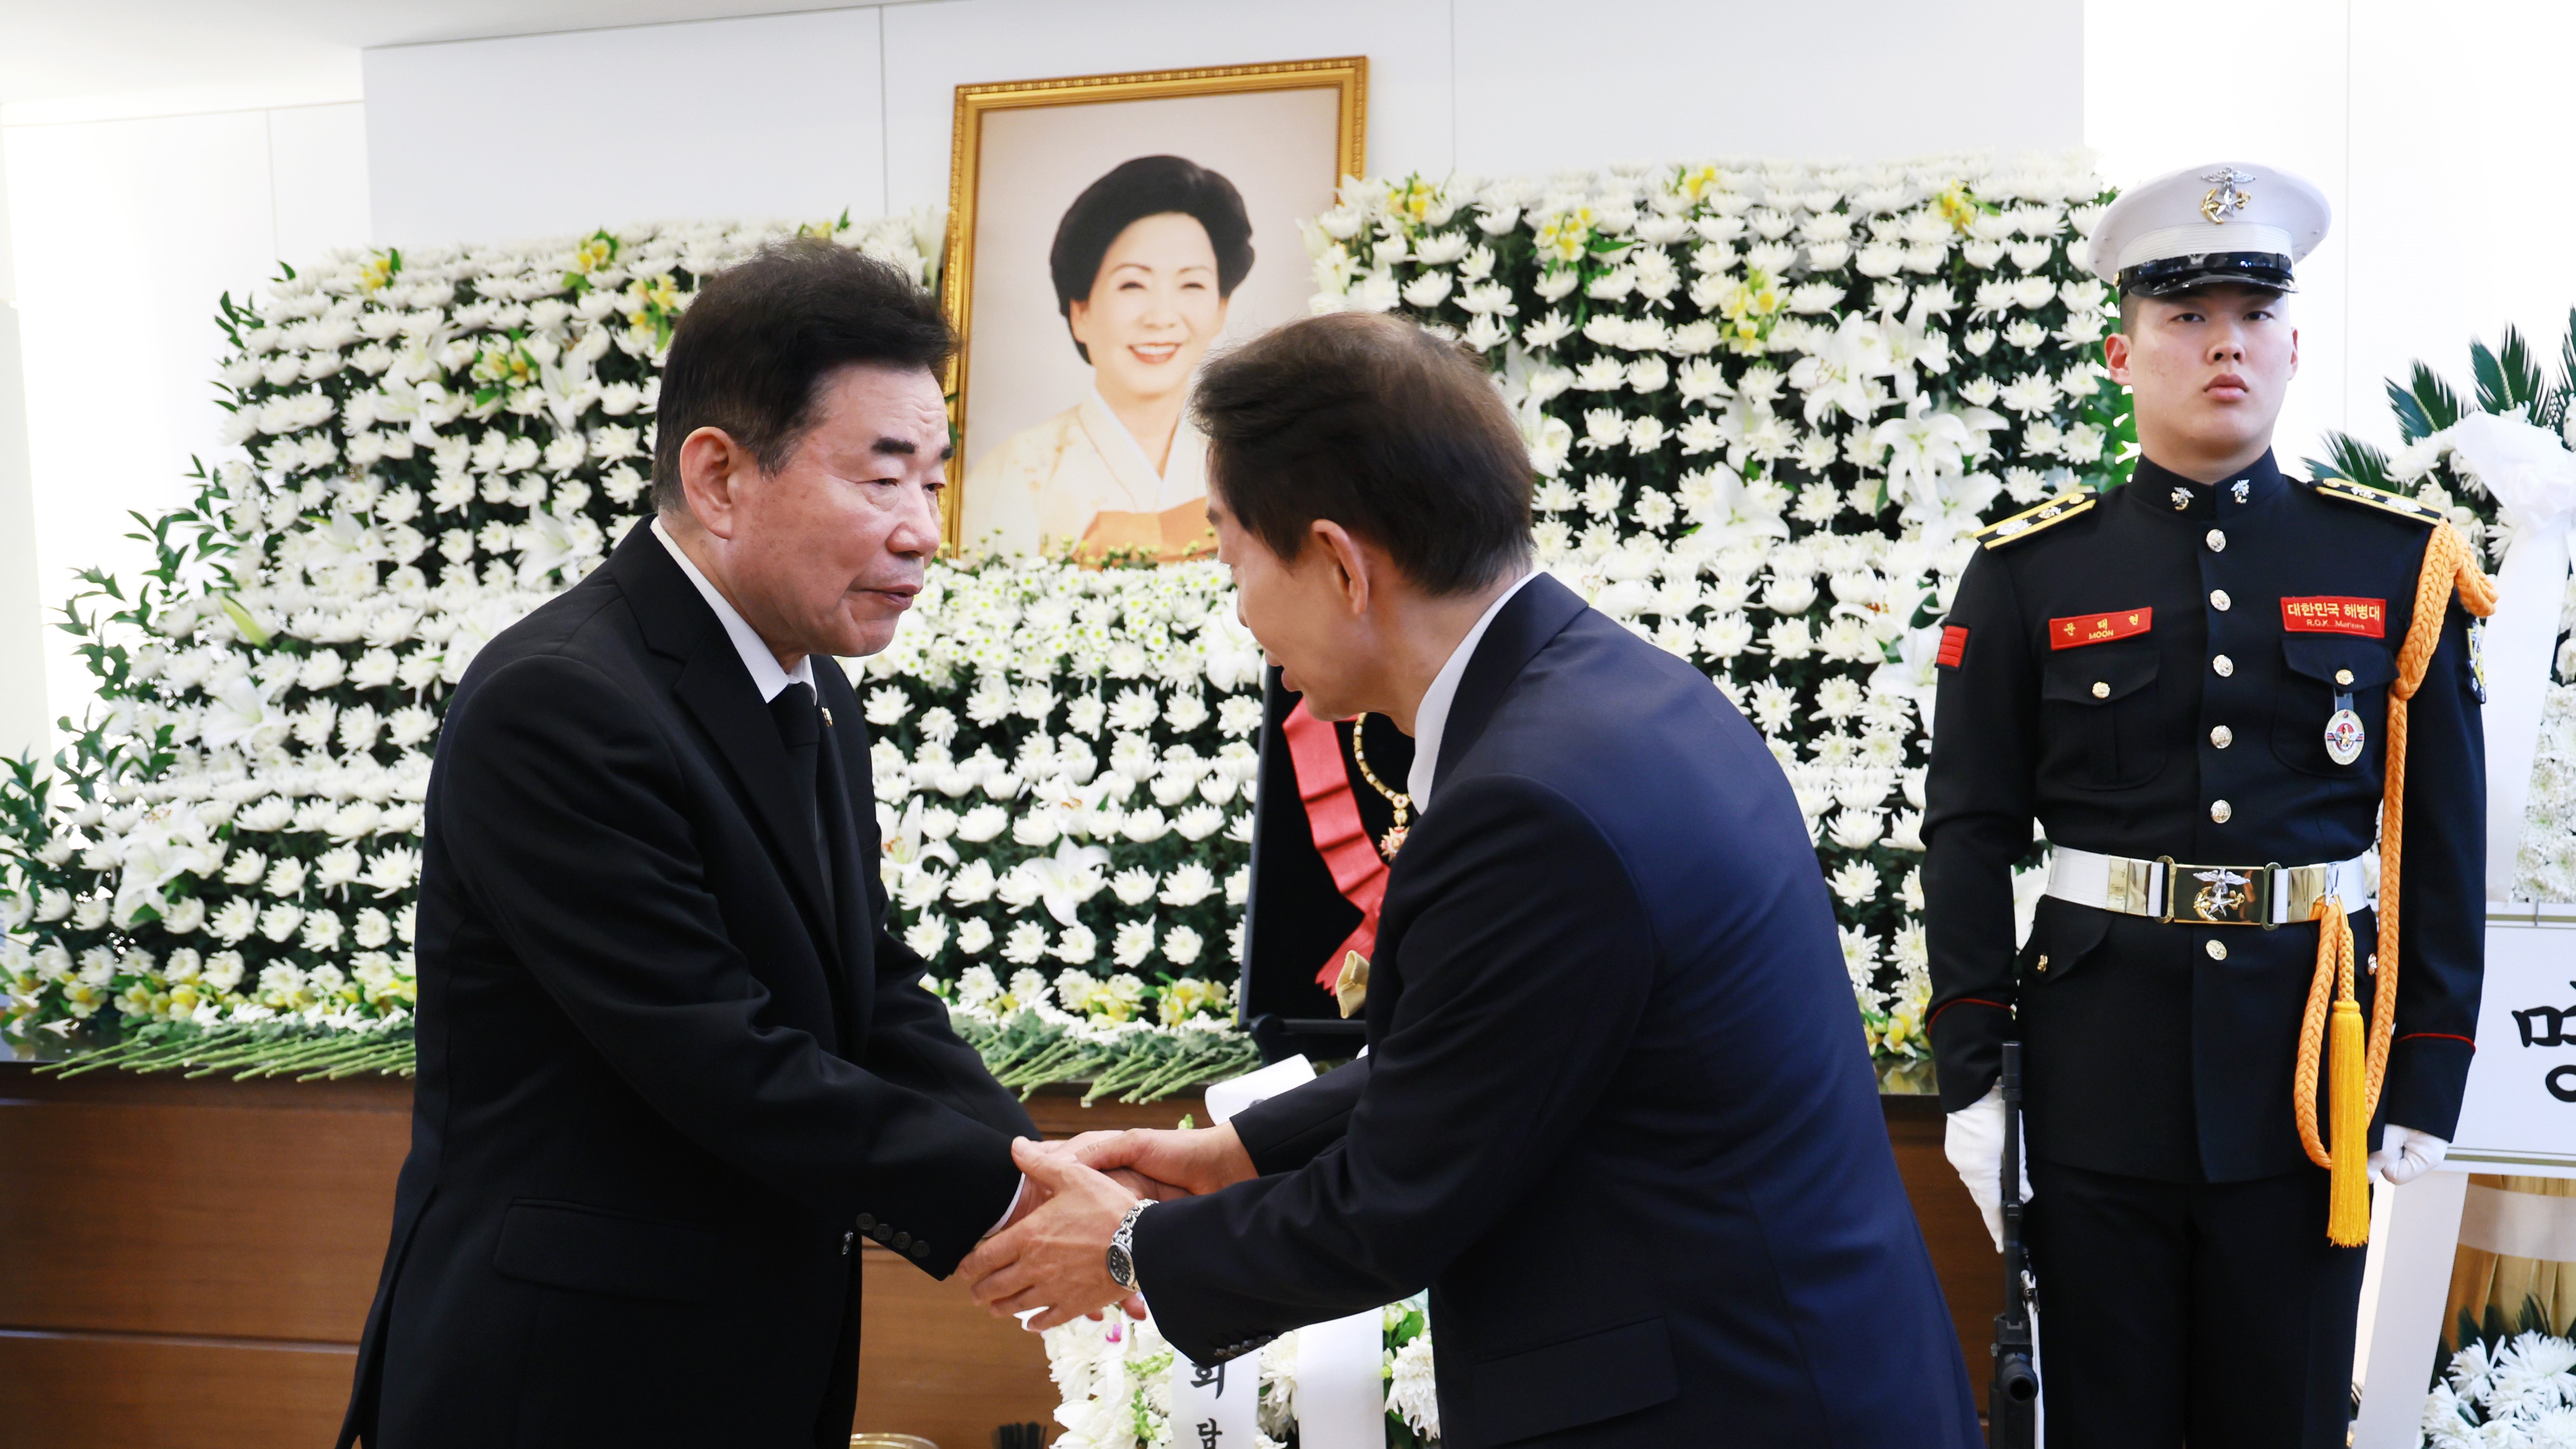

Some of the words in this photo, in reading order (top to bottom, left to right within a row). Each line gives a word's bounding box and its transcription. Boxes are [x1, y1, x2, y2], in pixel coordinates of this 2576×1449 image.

[2287, 602, 2340, 617] 대한민국
[2343, 603, 2380, 621] 해병대
[2097, 619, 2108, 629] 태
[2089, 630, 2114, 639] MOON
